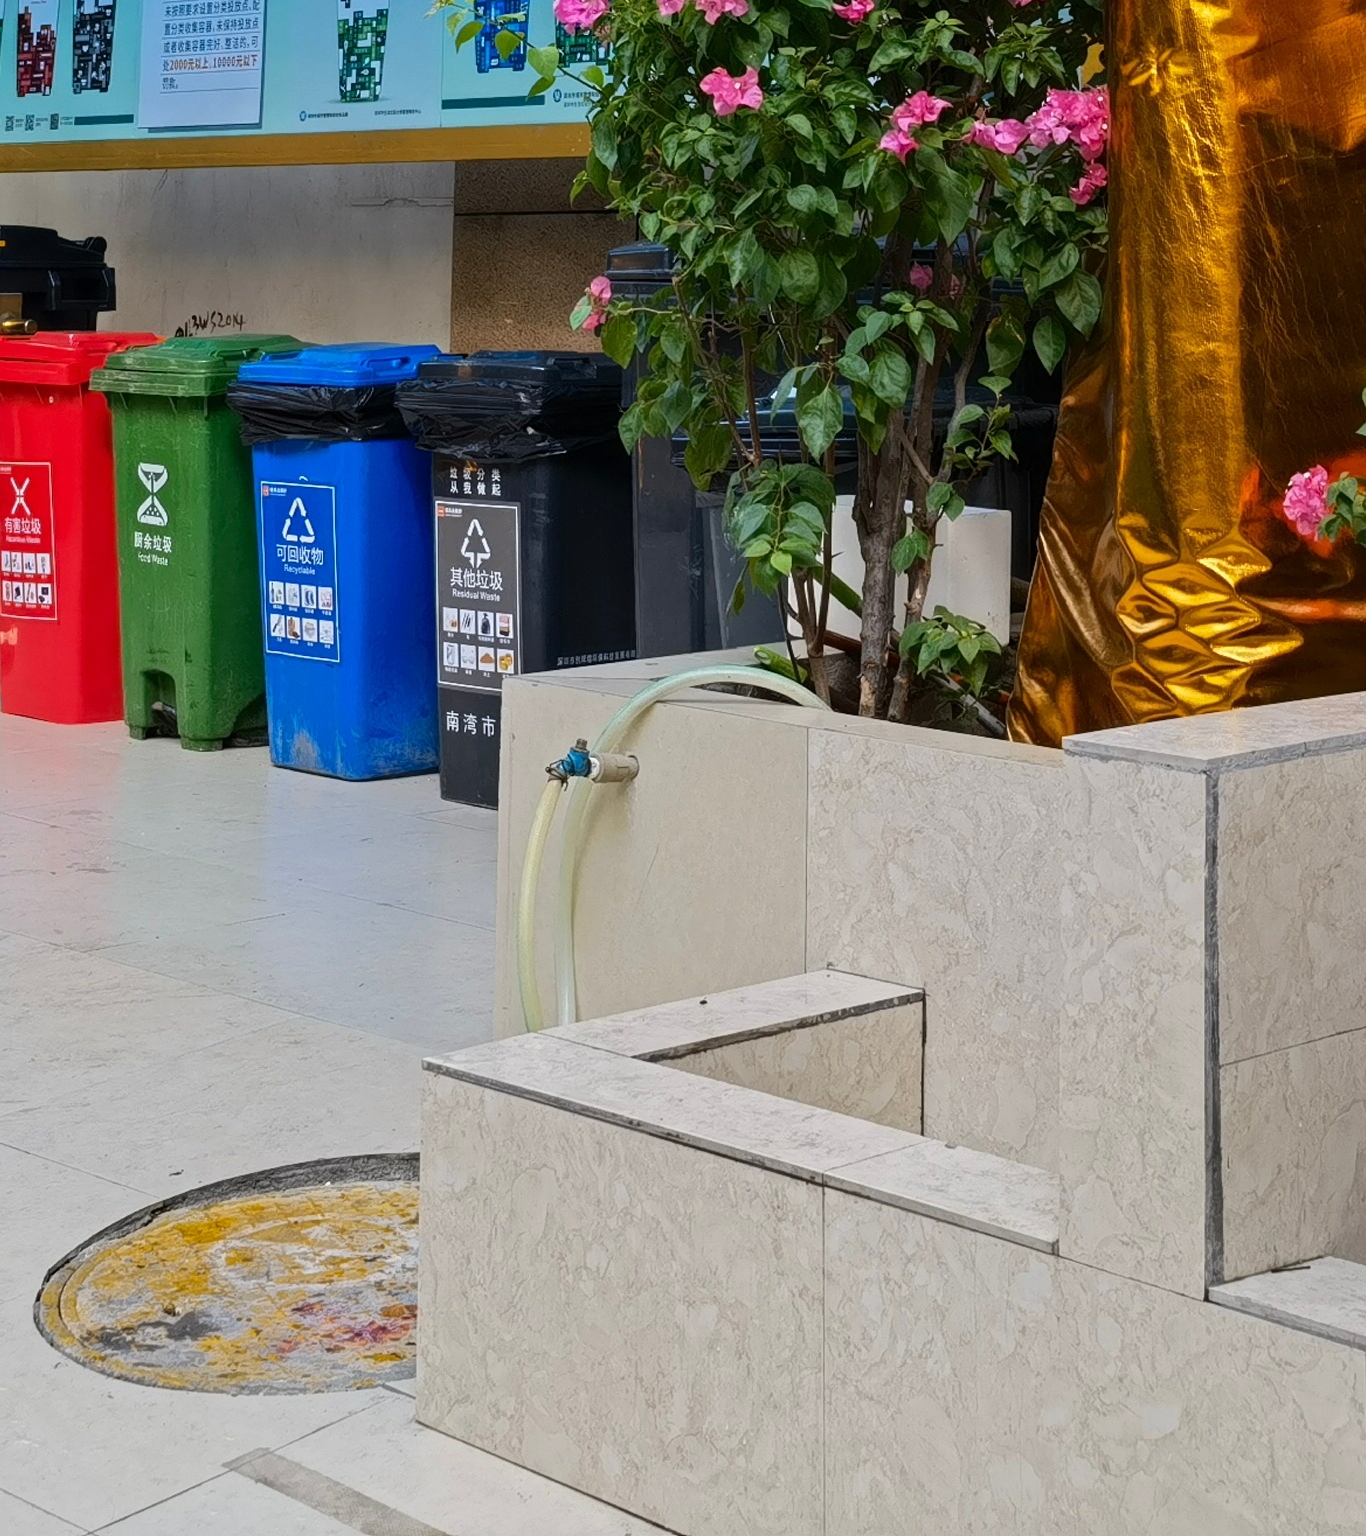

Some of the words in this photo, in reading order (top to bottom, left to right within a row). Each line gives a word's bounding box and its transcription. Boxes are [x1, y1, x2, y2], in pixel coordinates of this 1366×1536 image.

[450, 466, 501, 482] 垃圾分类
[450, 481, 501, 496] 从我做起
[5, 517, 42, 535] 有害垃圾
[134, 531, 172, 553] 厨余垃圾
[151, 554, 169, 566] Waste
[276, 544, 324, 566] 可回收物
[284, 564, 316, 575] Recyclable
[450, 567, 503, 592] 其他垃圾
[452, 588, 479, 600] Residual
[480, 591, 501, 602] Waste
[446, 710, 497, 737] 南湾市
